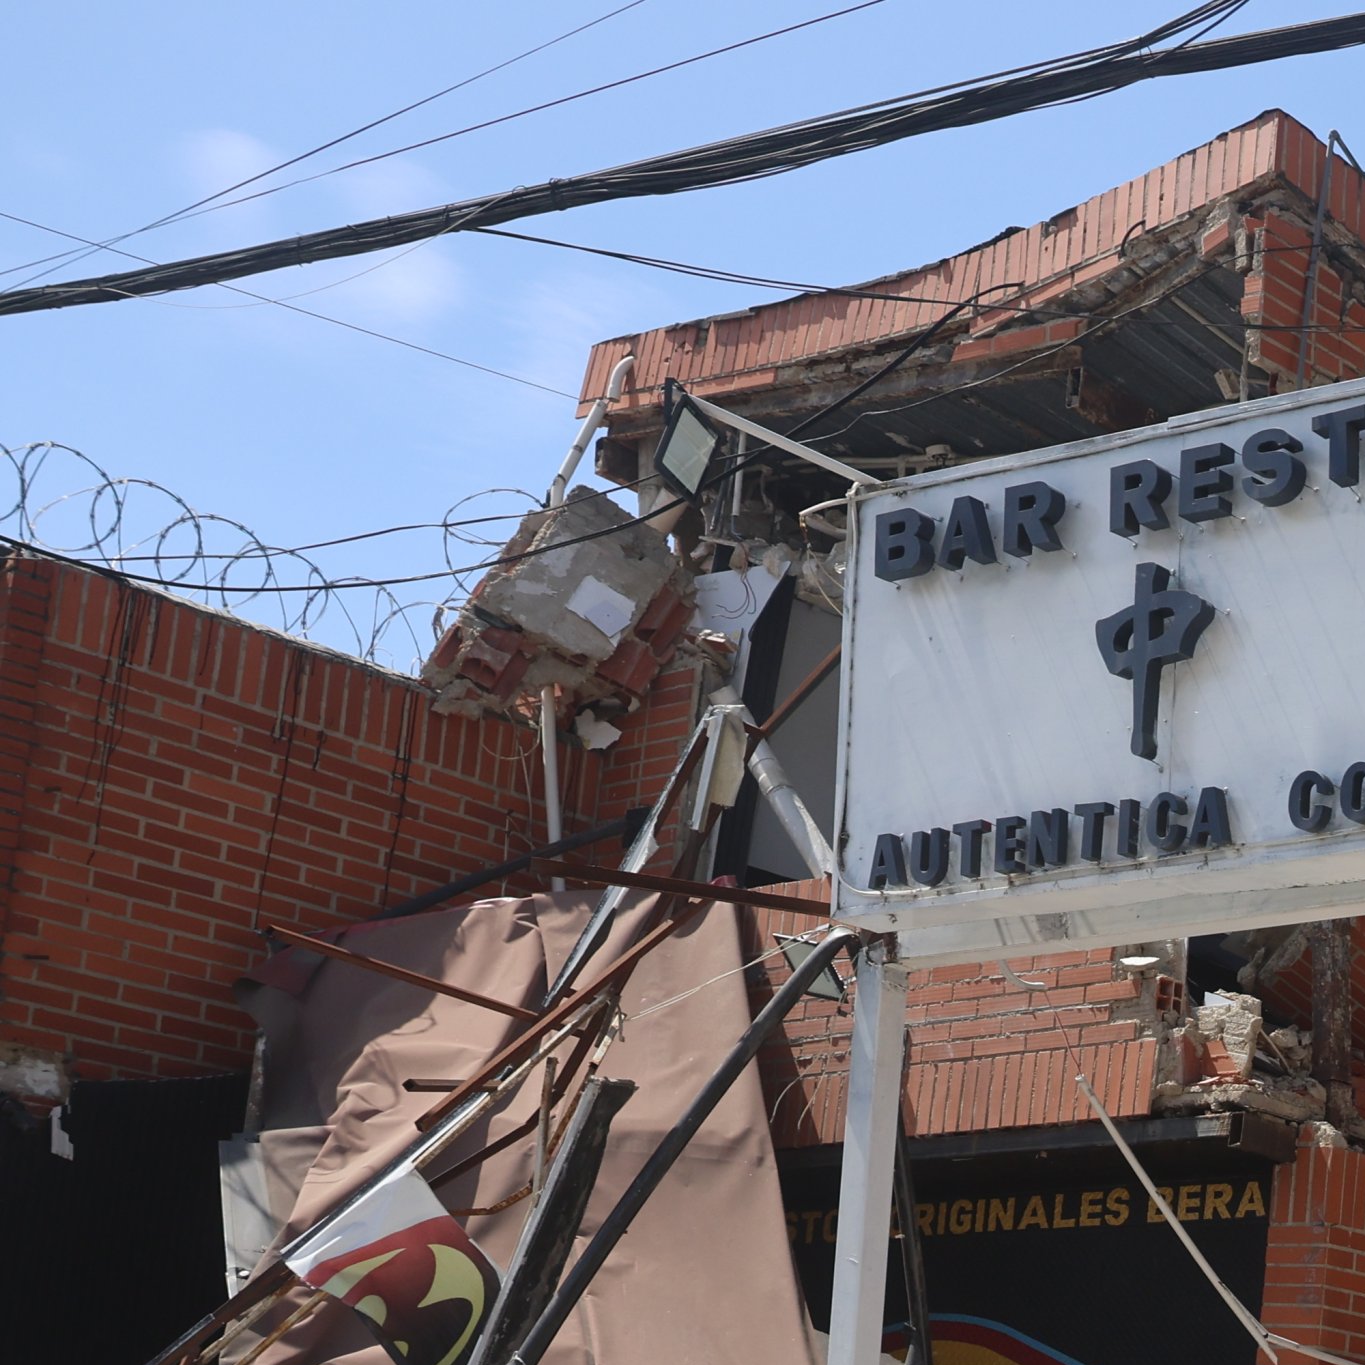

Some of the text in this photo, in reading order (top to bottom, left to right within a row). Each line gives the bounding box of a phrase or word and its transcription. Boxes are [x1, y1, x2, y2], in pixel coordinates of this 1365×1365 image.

[874, 482, 1065, 583] BAR
[868, 785, 1231, 891] AUTENTICA
[1147, 1181, 1267, 1223] BERA
